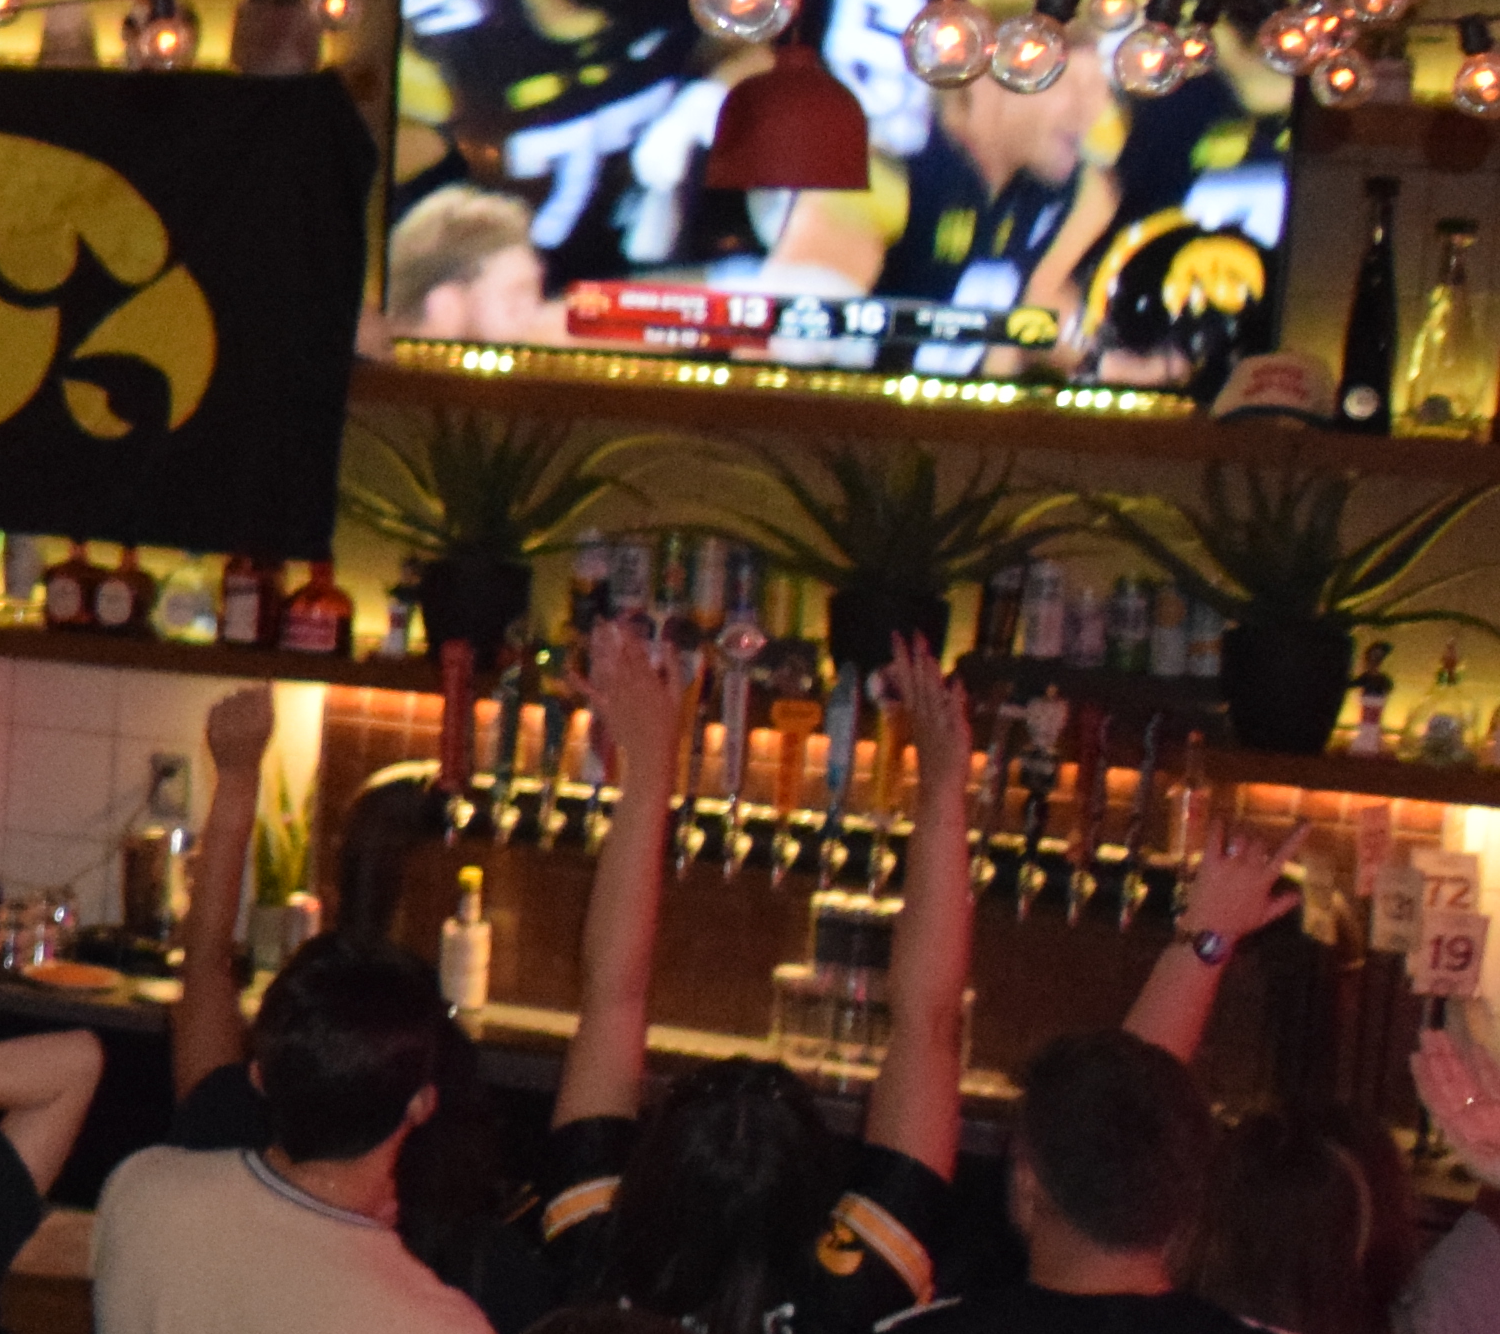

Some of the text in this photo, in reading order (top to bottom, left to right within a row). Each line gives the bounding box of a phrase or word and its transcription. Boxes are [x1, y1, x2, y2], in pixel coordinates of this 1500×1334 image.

[727, 296, 768, 328] 13
[843, 301, 885, 333] 16
[1423, 876, 1470, 908] 72
[1430, 935, 1473, 971] 19
